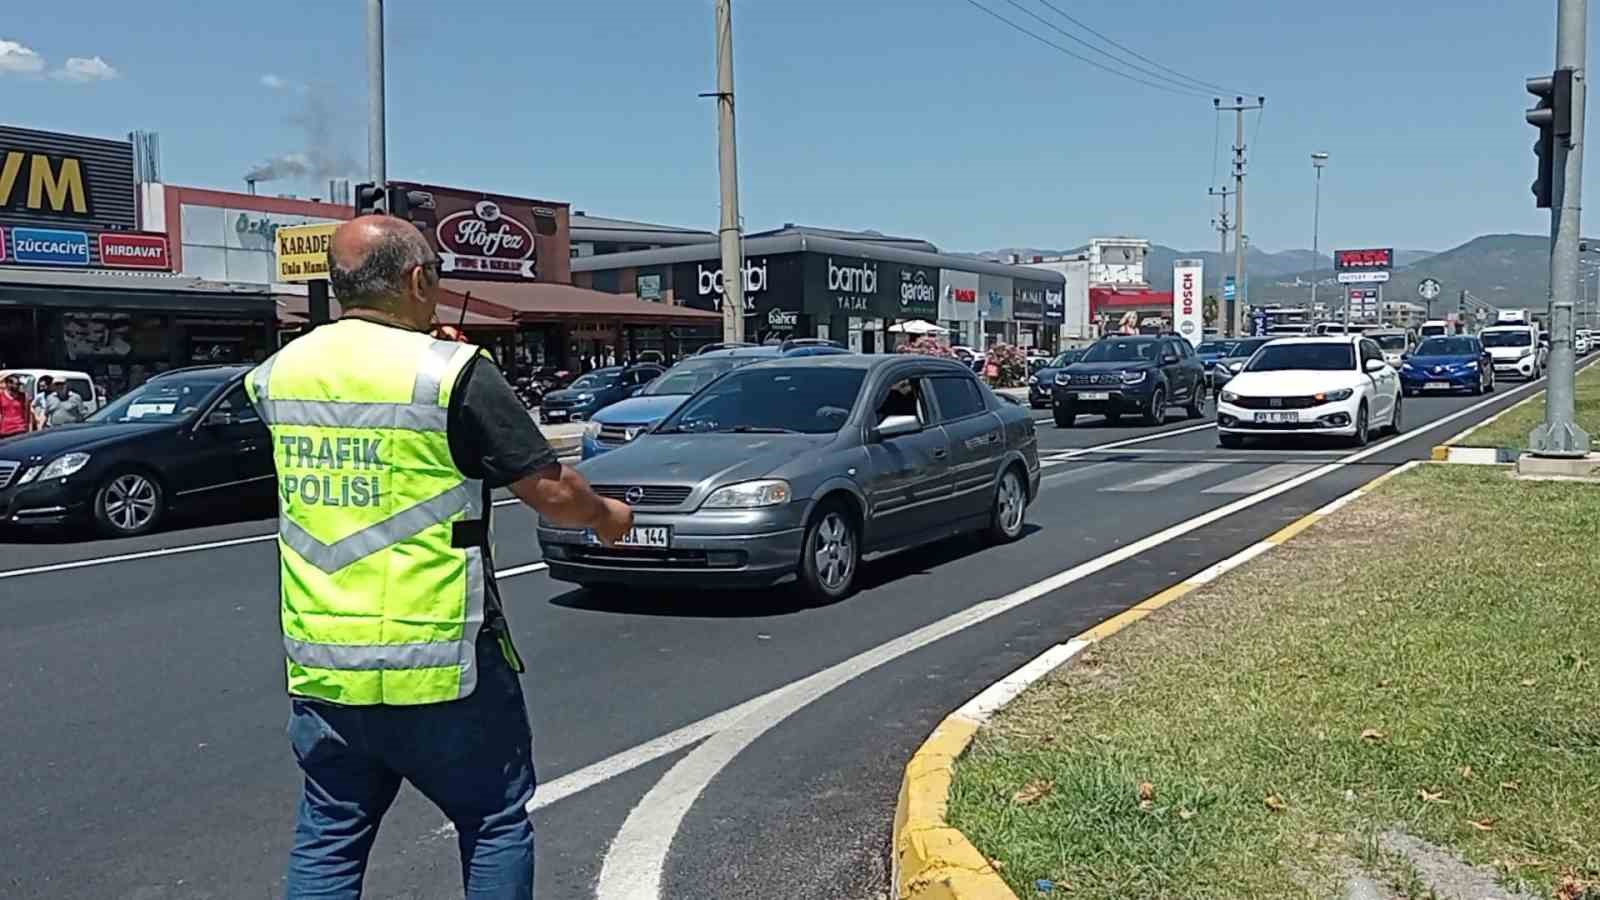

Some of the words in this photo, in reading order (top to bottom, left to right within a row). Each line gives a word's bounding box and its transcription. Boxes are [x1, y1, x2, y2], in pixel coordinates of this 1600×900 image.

[105, 244, 163, 258] HIRDAVAT
[454, 219, 524, 256] Körfez
[828, 257, 877, 294] bambi
[837, 297, 867, 310] YATAK
[900, 282, 934, 305] garden
[1182, 273, 1193, 315] BOSCH
[279, 436, 384, 470] TRAFİK
[284, 474, 380, 507] POLİSİ
[645, 528, 666, 545] 144
